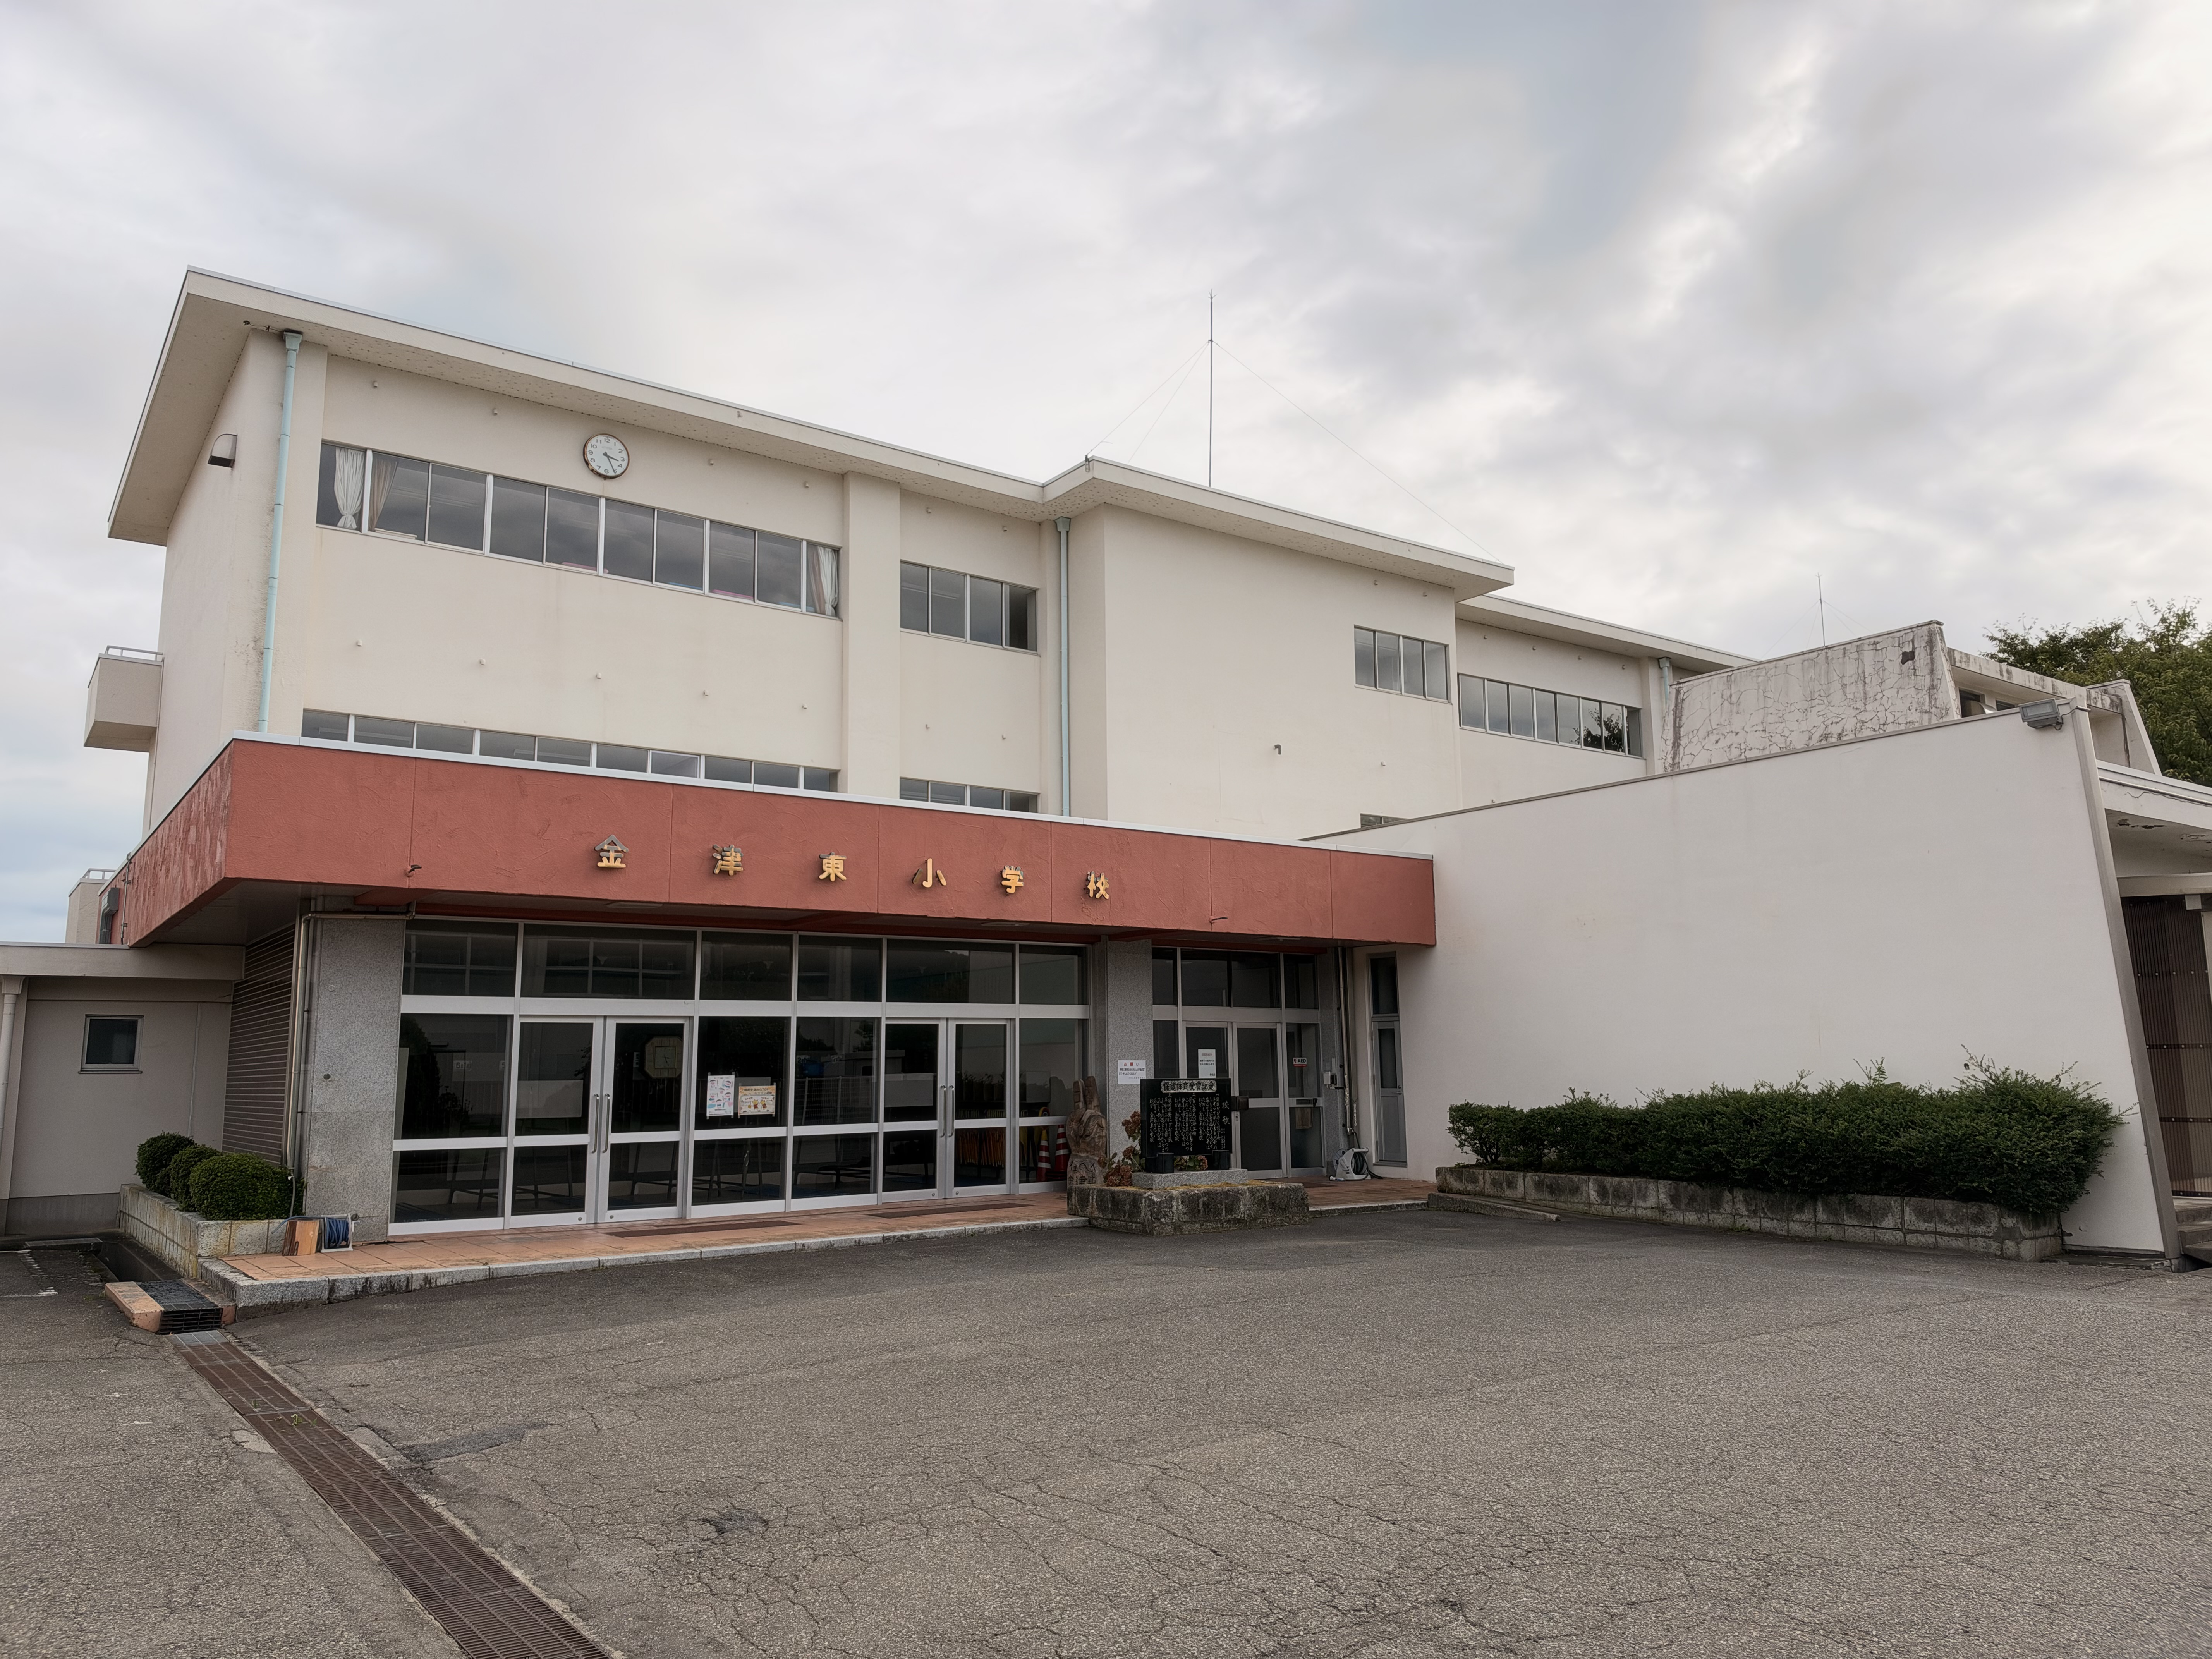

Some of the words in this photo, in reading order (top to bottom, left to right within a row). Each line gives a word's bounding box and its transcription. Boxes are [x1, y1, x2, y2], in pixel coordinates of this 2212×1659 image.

[595, 834, 1110, 900] 金津東小学校
